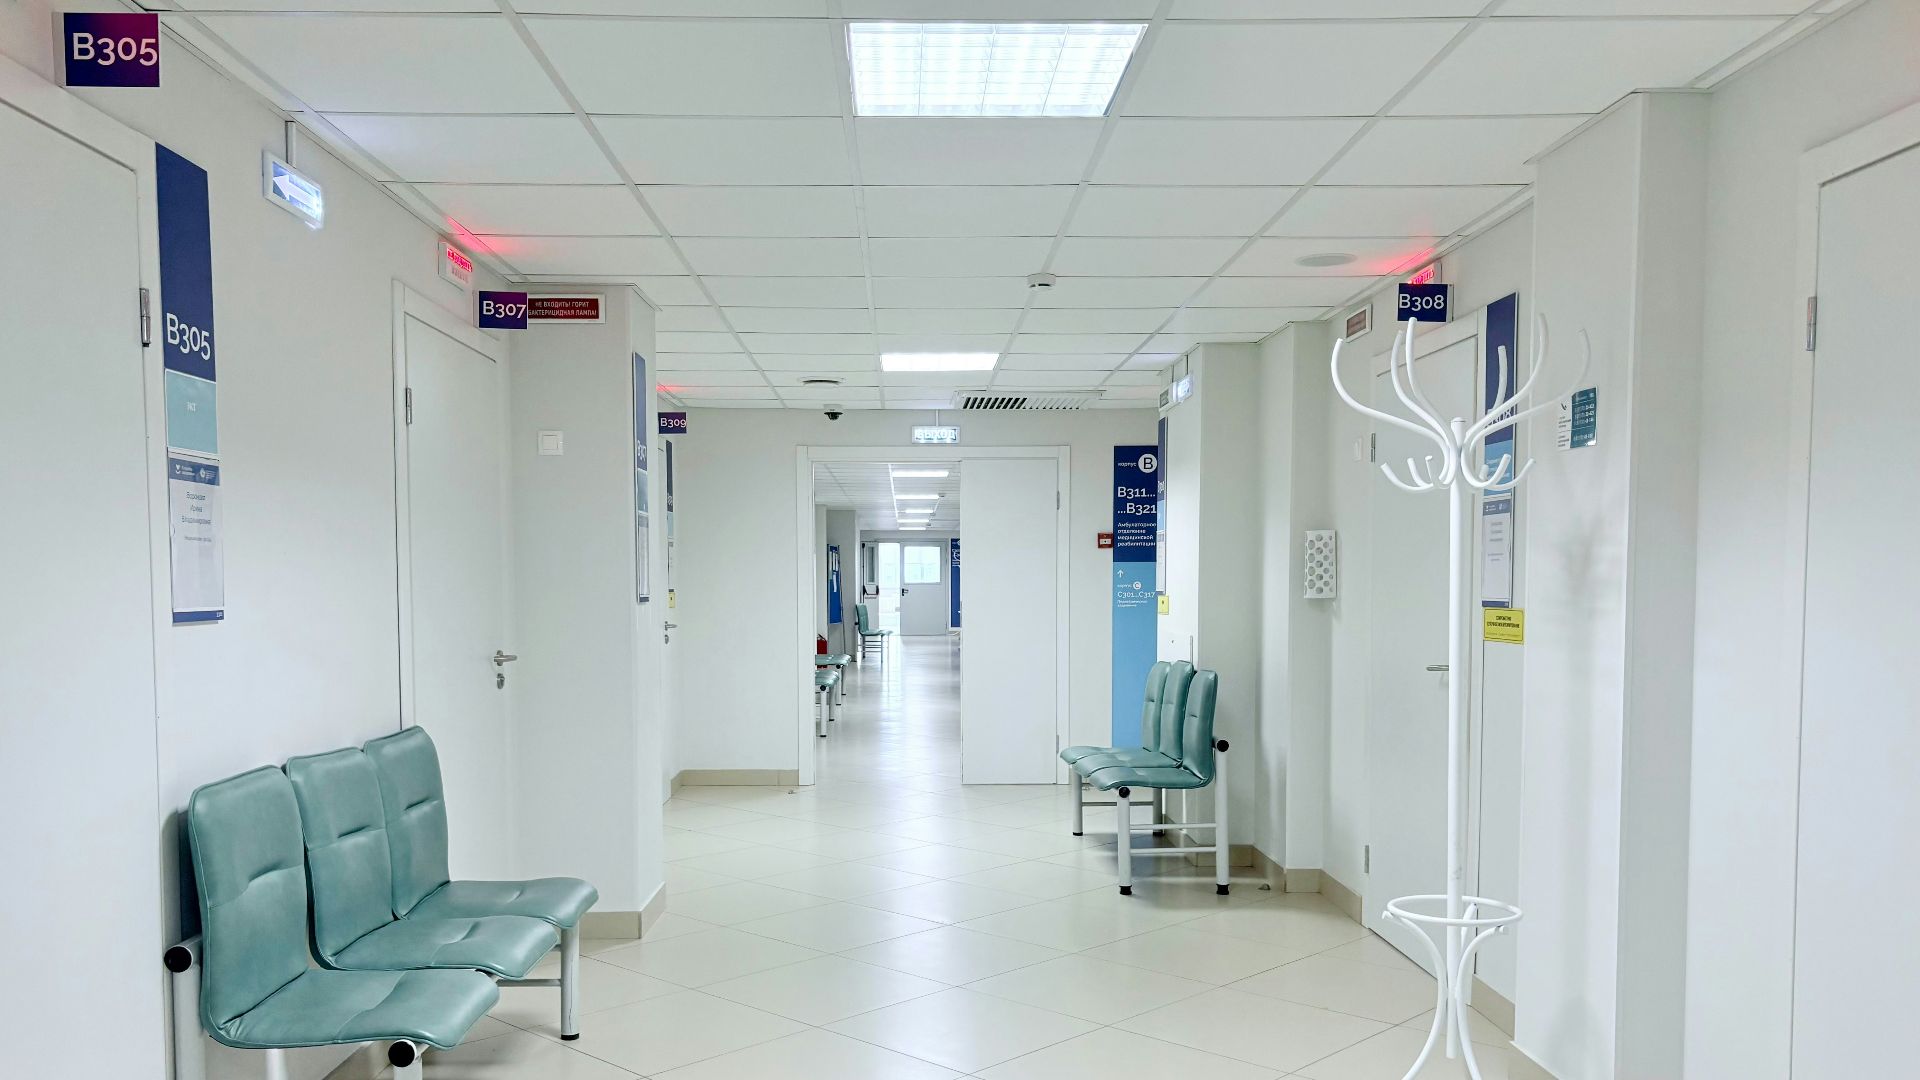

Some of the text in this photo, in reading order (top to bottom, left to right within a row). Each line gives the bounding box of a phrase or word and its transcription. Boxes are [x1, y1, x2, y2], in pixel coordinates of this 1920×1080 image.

[73, 32, 158, 67] B305
[482, 300, 527, 319] B307
[543, 301, 571, 309] ВХОДИТЬ!
[1399, 293, 1445, 312] B308
[166, 312, 211, 361] B305
[660, 417, 687, 428] B309
[1143, 457, 1154, 470] B
